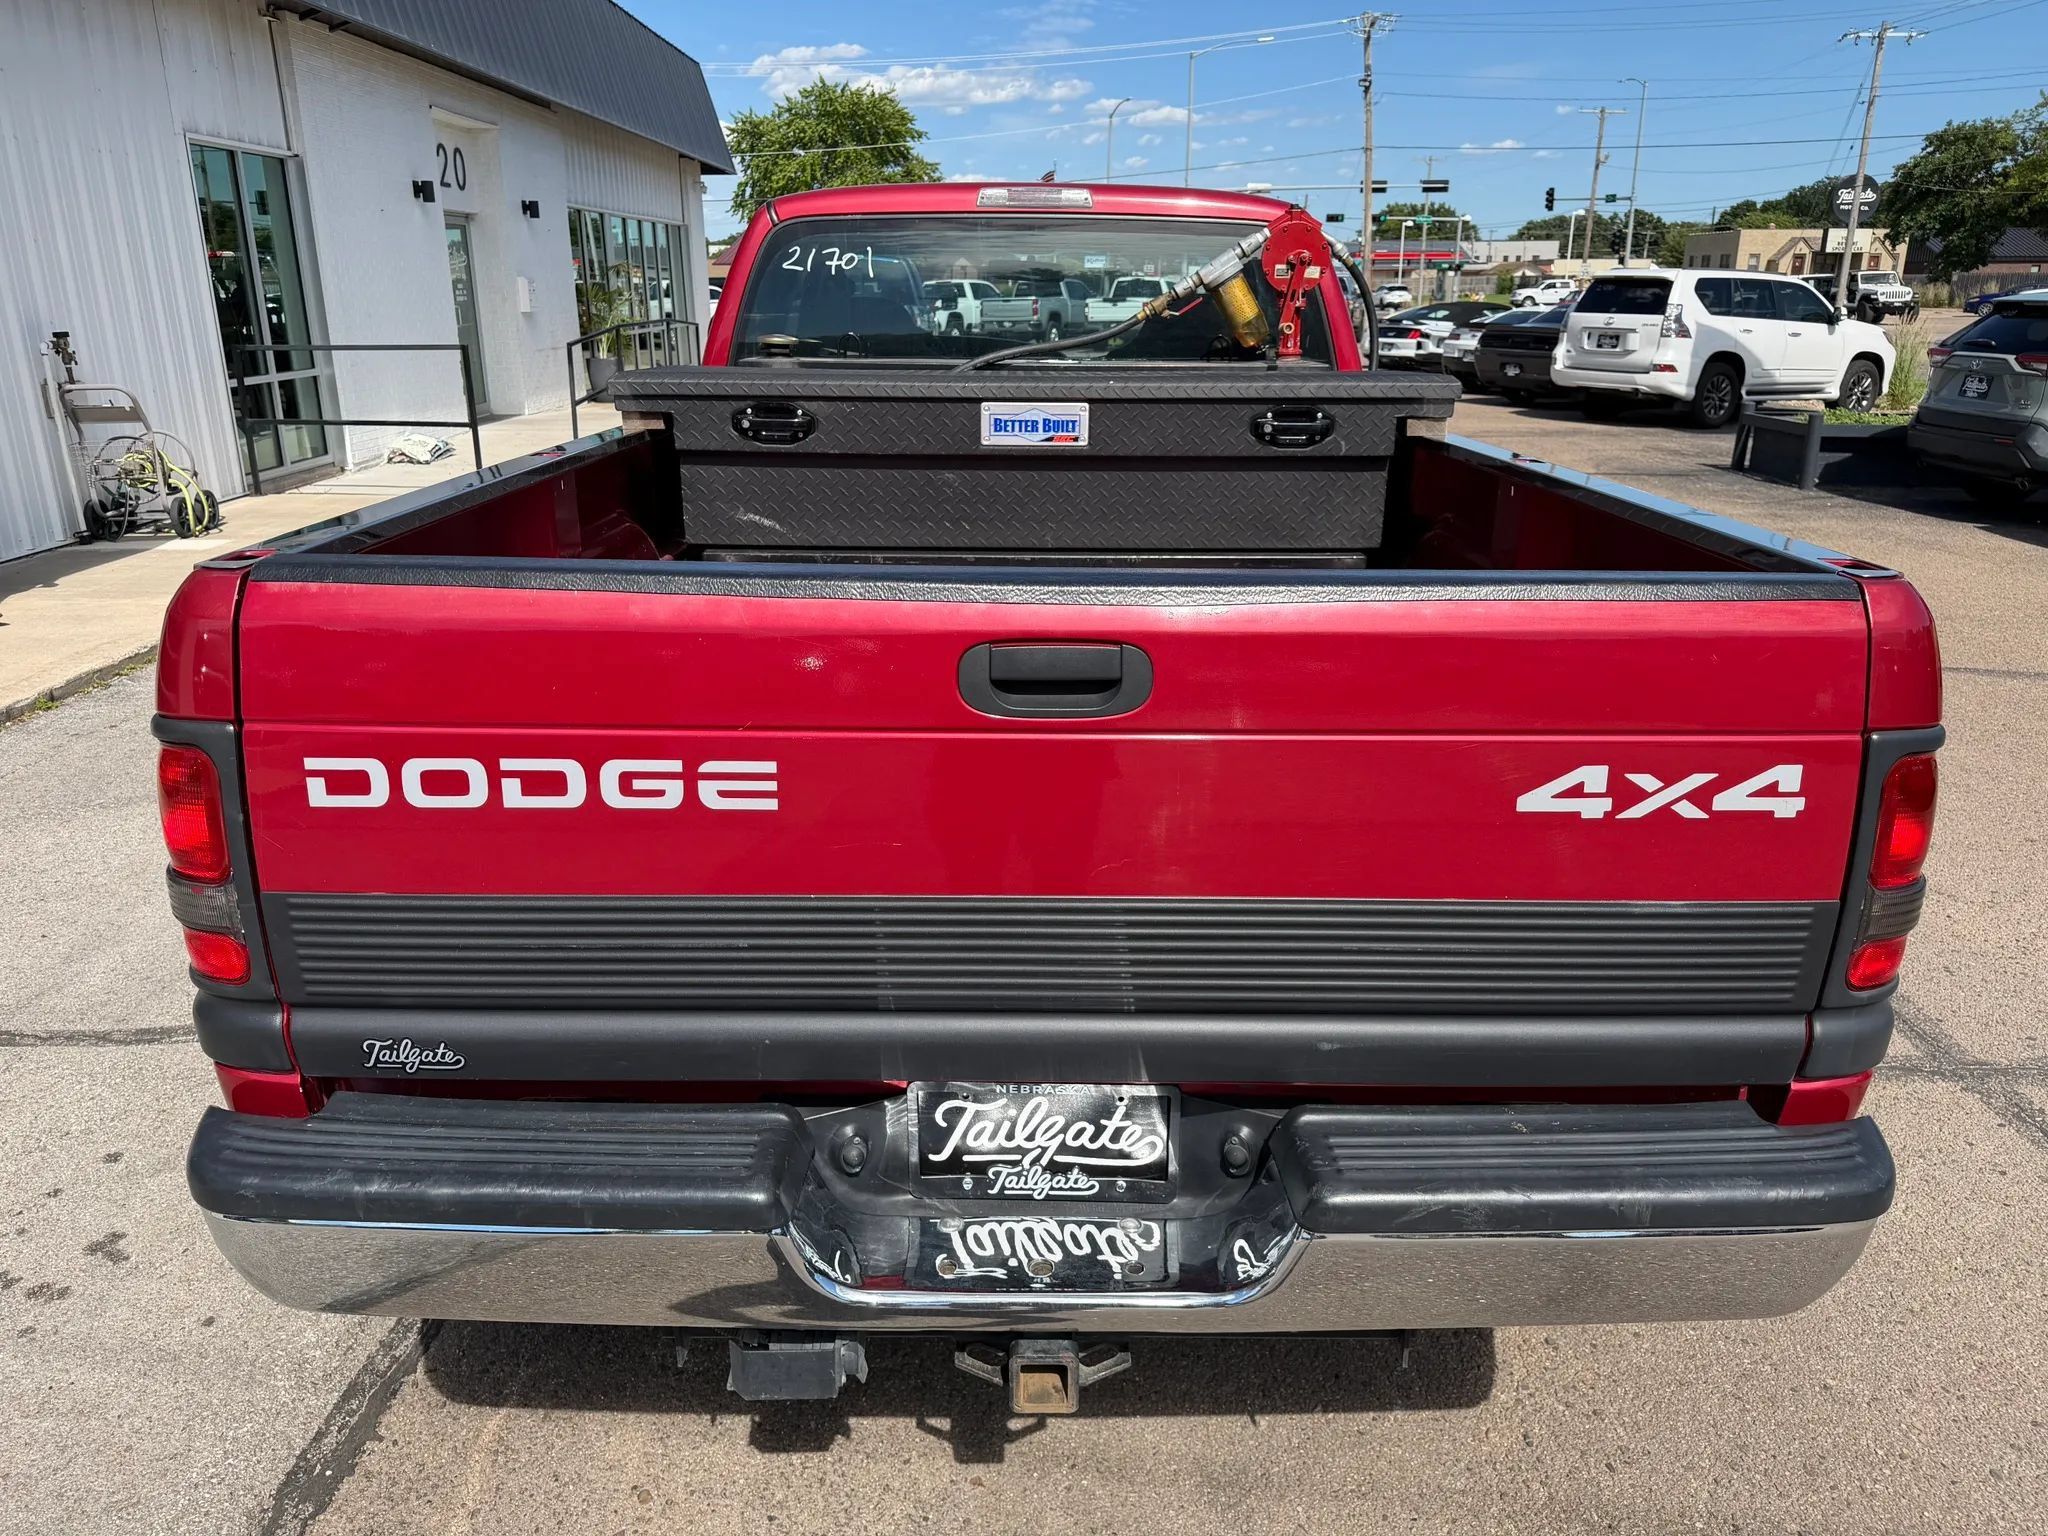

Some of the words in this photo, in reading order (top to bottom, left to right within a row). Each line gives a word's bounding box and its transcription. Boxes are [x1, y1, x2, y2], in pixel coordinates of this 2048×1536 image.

[436, 142, 467, 191] 20
[1836, 188, 1877, 204] Tailate
[782, 246, 874, 278] 21701
[993, 417, 1039, 433] BETTER
[1042, 417, 1078, 433] BUILT
[303, 757, 779, 810] DODGE
[362, 1038, 465, 1073] Tailgate
[996, 1084, 1092, 1095] NEBRASKA
[928, 1096, 1164, 1168] Tailgate
[987, 1166, 1100, 1200] Tailgate
